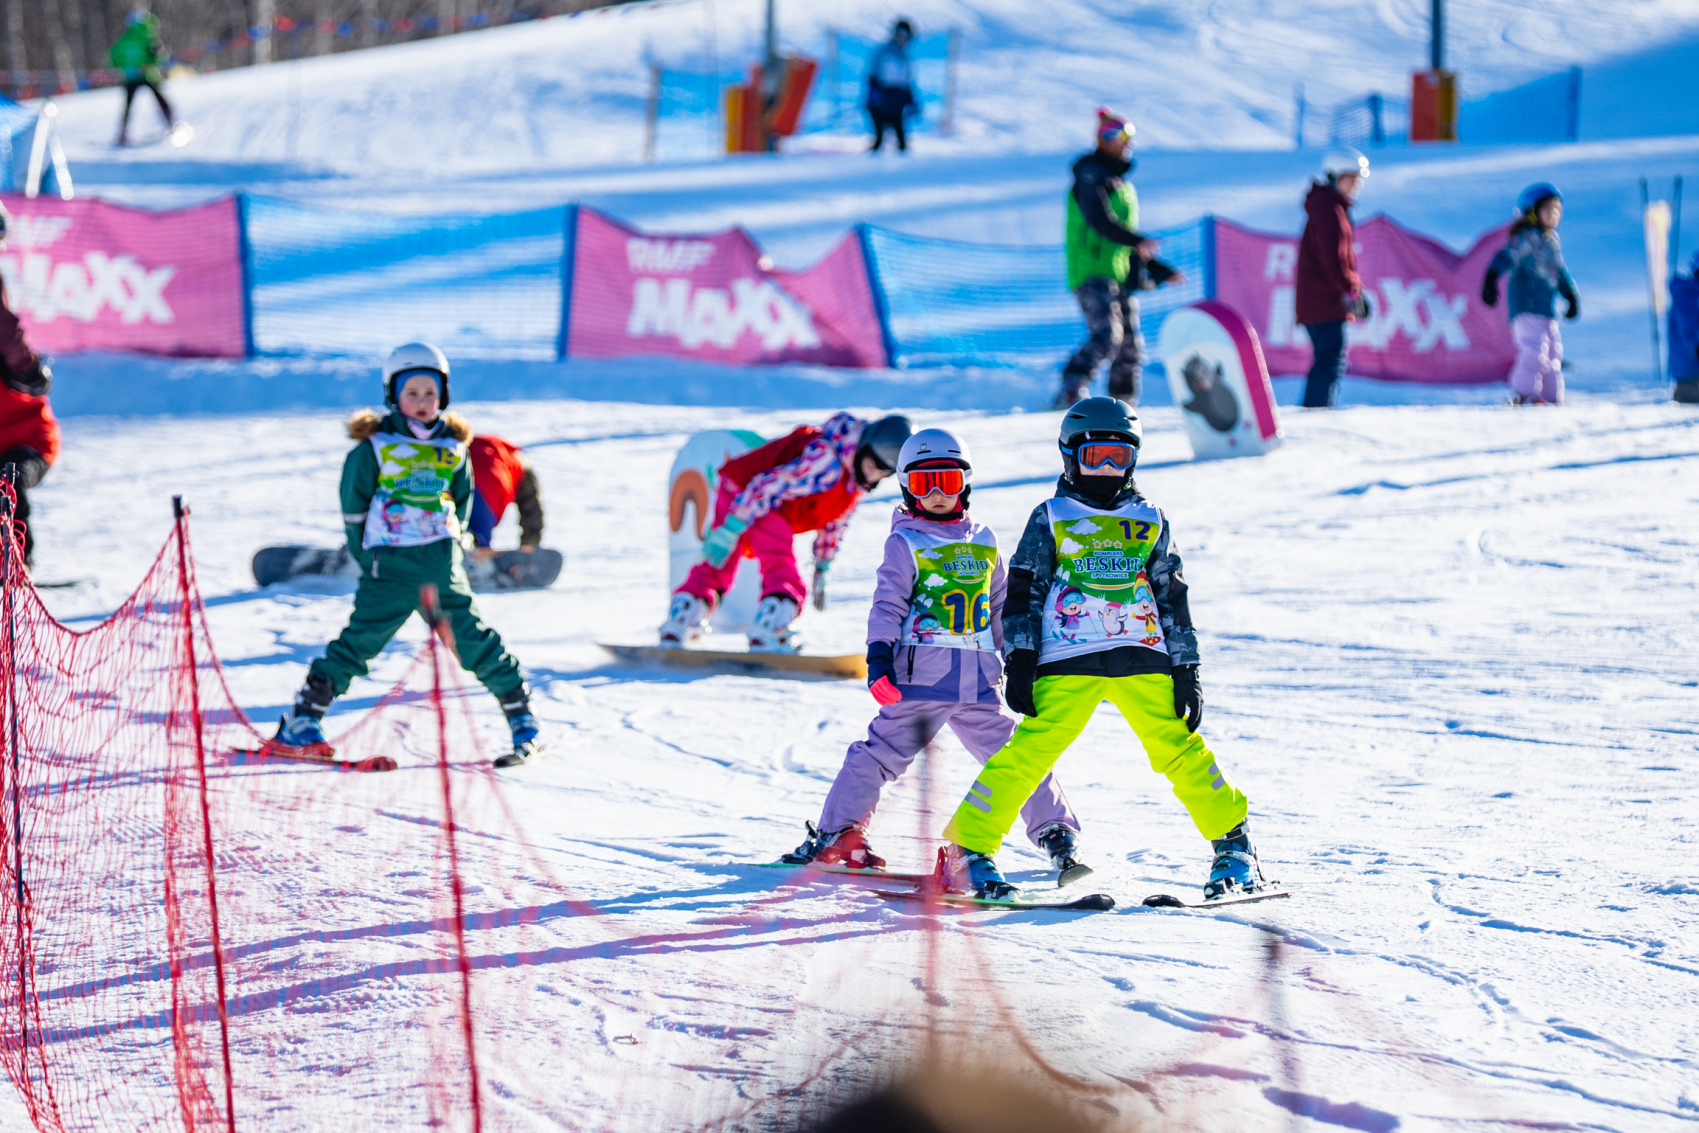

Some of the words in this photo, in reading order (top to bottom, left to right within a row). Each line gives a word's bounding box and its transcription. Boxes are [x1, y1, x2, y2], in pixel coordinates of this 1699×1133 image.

[626, 237, 717, 273] RMF
[627, 276, 822, 350] MAXX
[1118, 519, 1151, 541] 12
[942, 560, 989, 572] BESKID
[941, 589, 990, 635] 16
